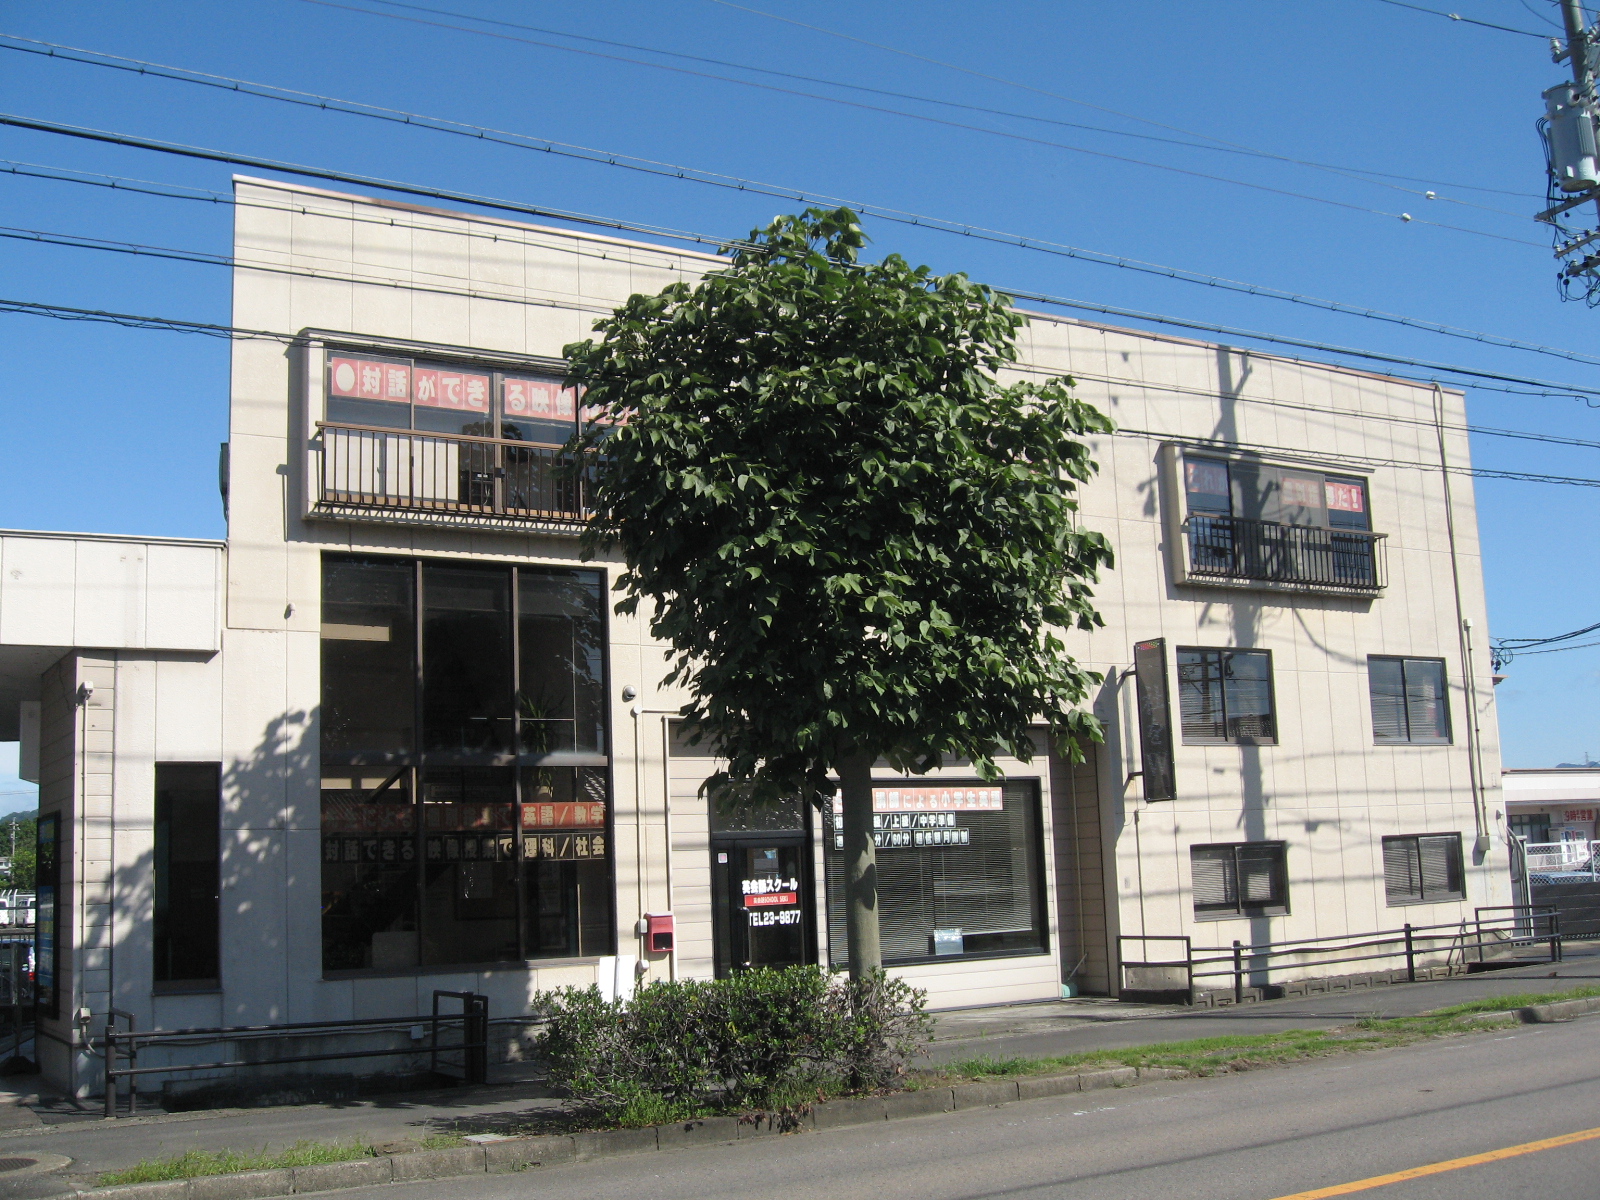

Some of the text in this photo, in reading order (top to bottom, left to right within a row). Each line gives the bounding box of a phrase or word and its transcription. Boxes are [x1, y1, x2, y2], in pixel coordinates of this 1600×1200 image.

[741, 878, 799, 895] 英会話スクール
[749, 909, 801, 926] TEL23-9877
